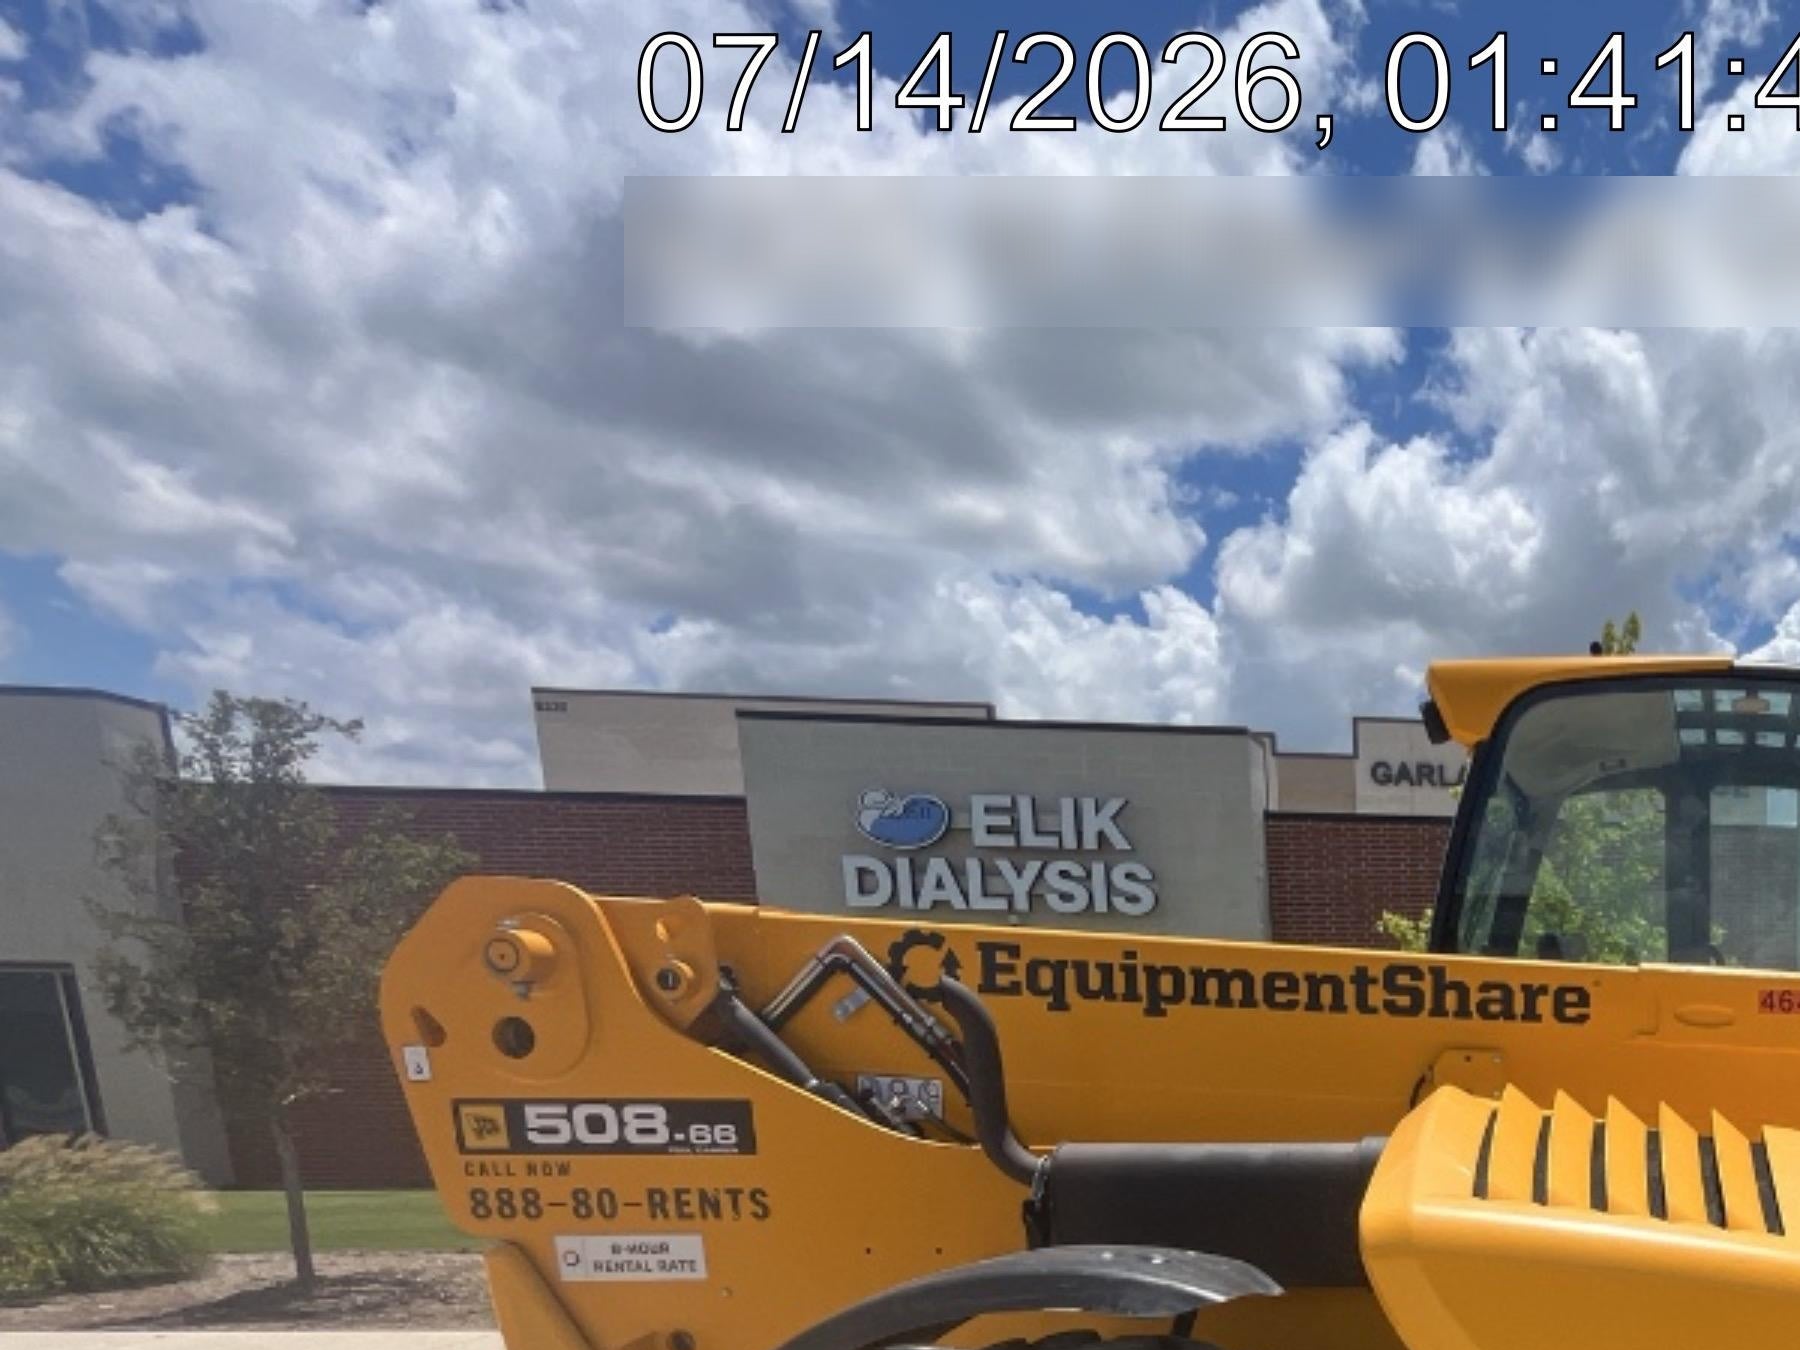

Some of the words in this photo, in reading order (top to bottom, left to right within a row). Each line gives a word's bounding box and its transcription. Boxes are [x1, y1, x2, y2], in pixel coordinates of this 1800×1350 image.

[971, 794, 1132, 850] ELIK
[842, 855, 1156, 915] DIALYSIS
[976, 942, 1591, 1025] EquipmentShare
[463, 1160, 517, 1177] CALL
[527, 1160, 572, 1177] NOW
[469, 1187, 771, 1221] 888-80-RENTS
[593, 1259, 653, 1273] RENTAL
[656, 1259, 697, 1273] RATE
